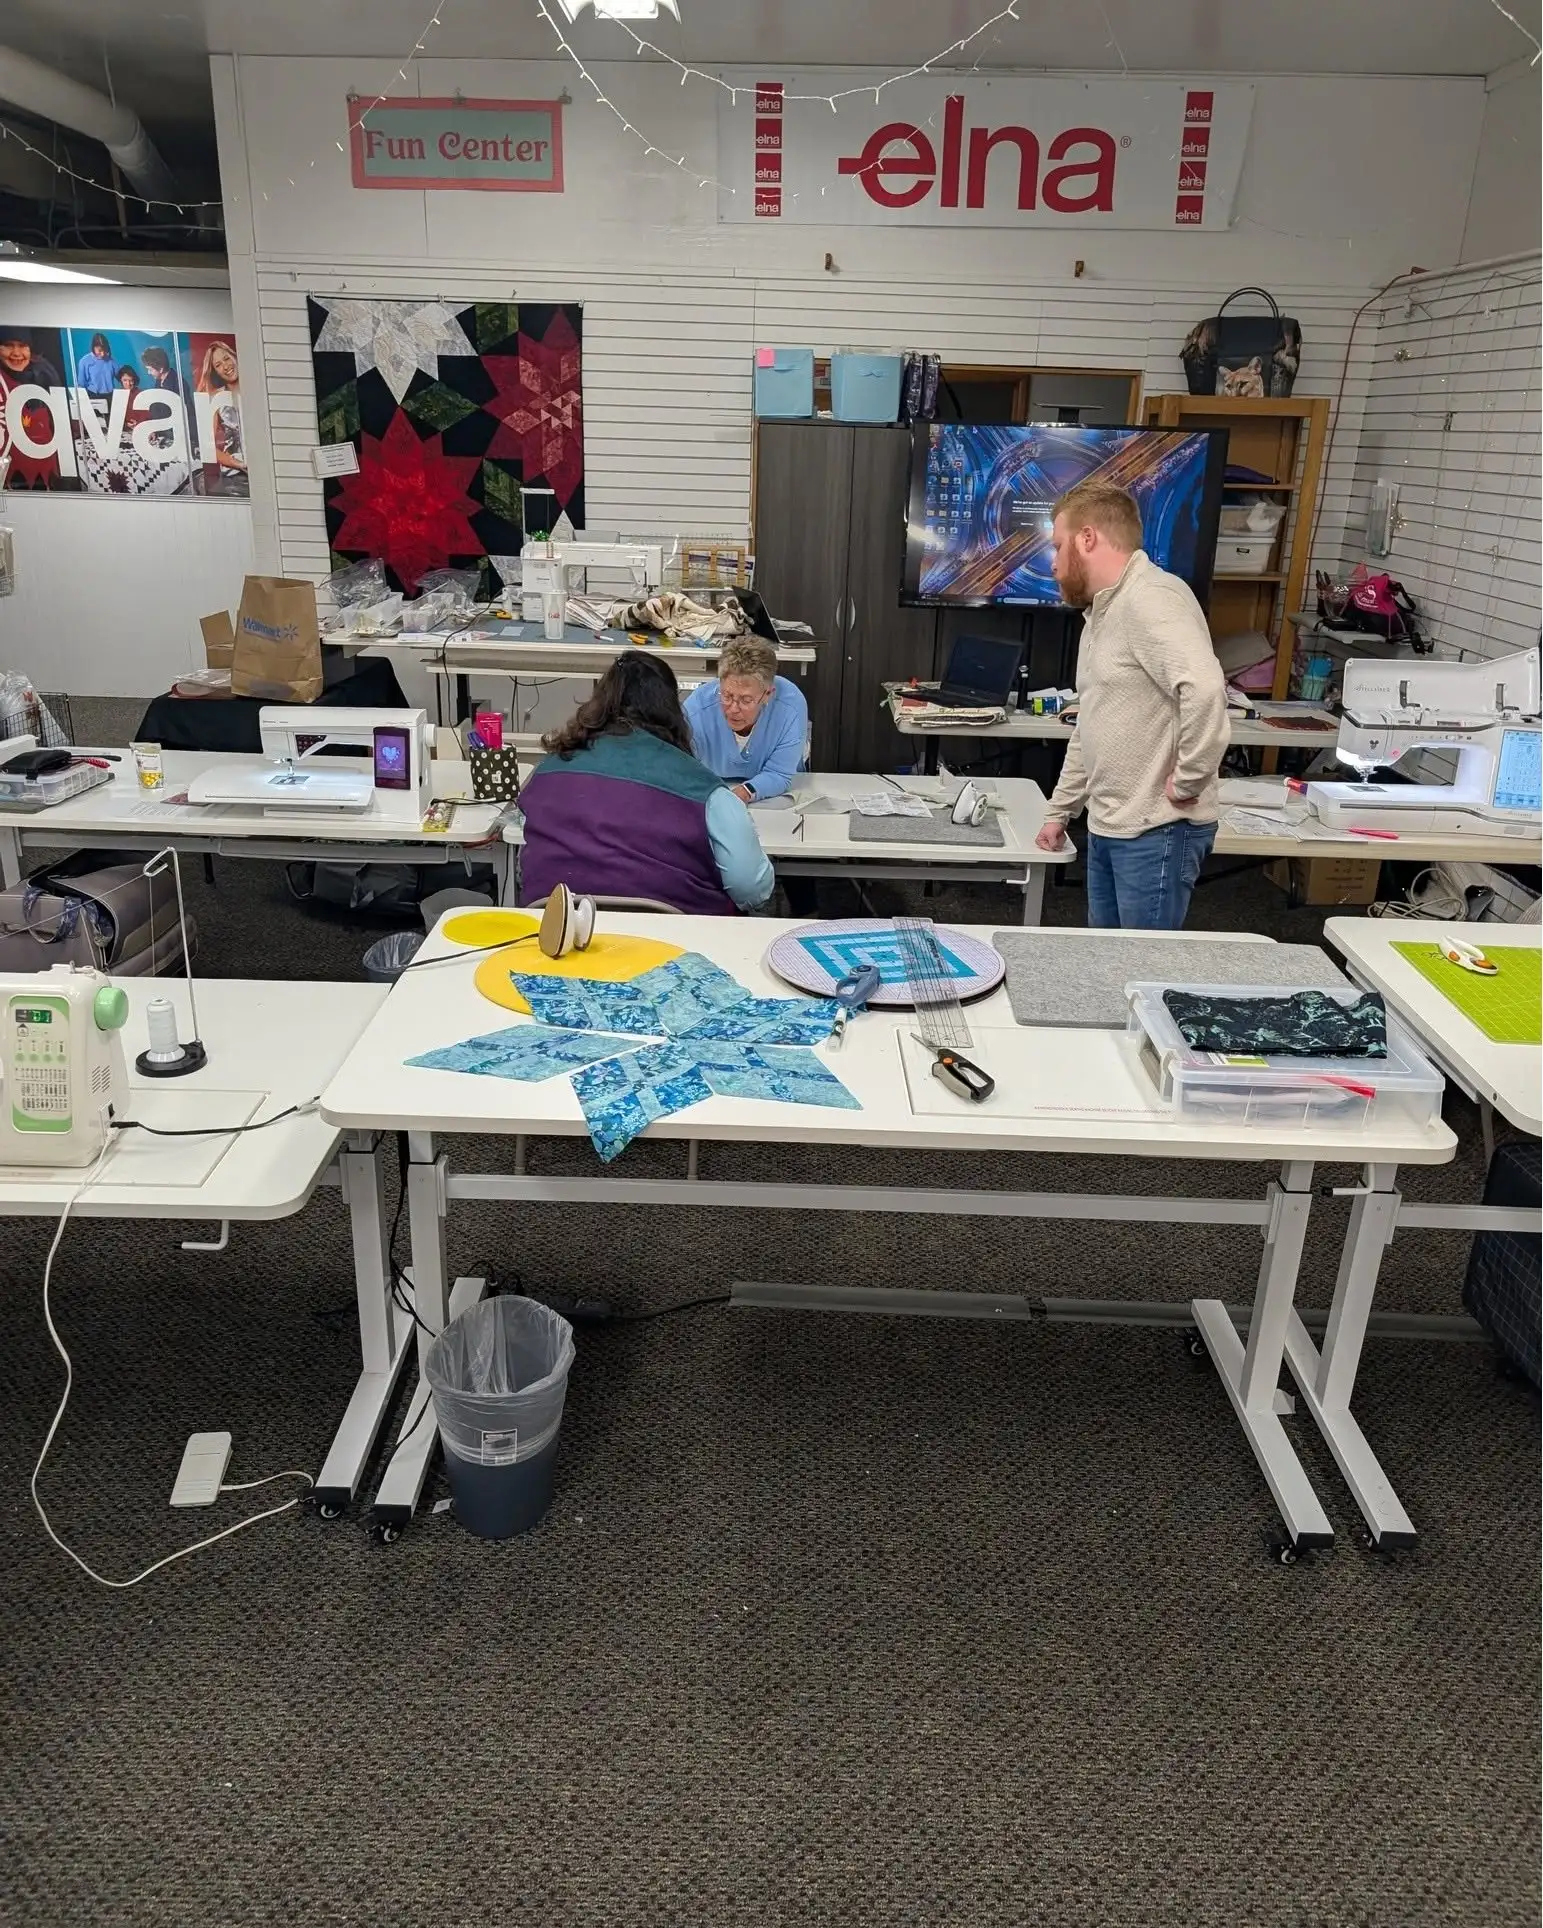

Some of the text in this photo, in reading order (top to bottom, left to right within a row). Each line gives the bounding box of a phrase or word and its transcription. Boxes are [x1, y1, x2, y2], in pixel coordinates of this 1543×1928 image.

[756, 99, 780, 110] elna
[1185, 107, 1210, 118] elna
[756, 134, 780, 145] elna
[364, 130, 549, 162] Fun Center
[1181, 142, 1206, 153] elna
[755, 168, 779, 179] elna
[755, 202, 779, 213] elna
[1176, 209, 1200, 220] elna
[242, 616, 281, 639] Walmart
